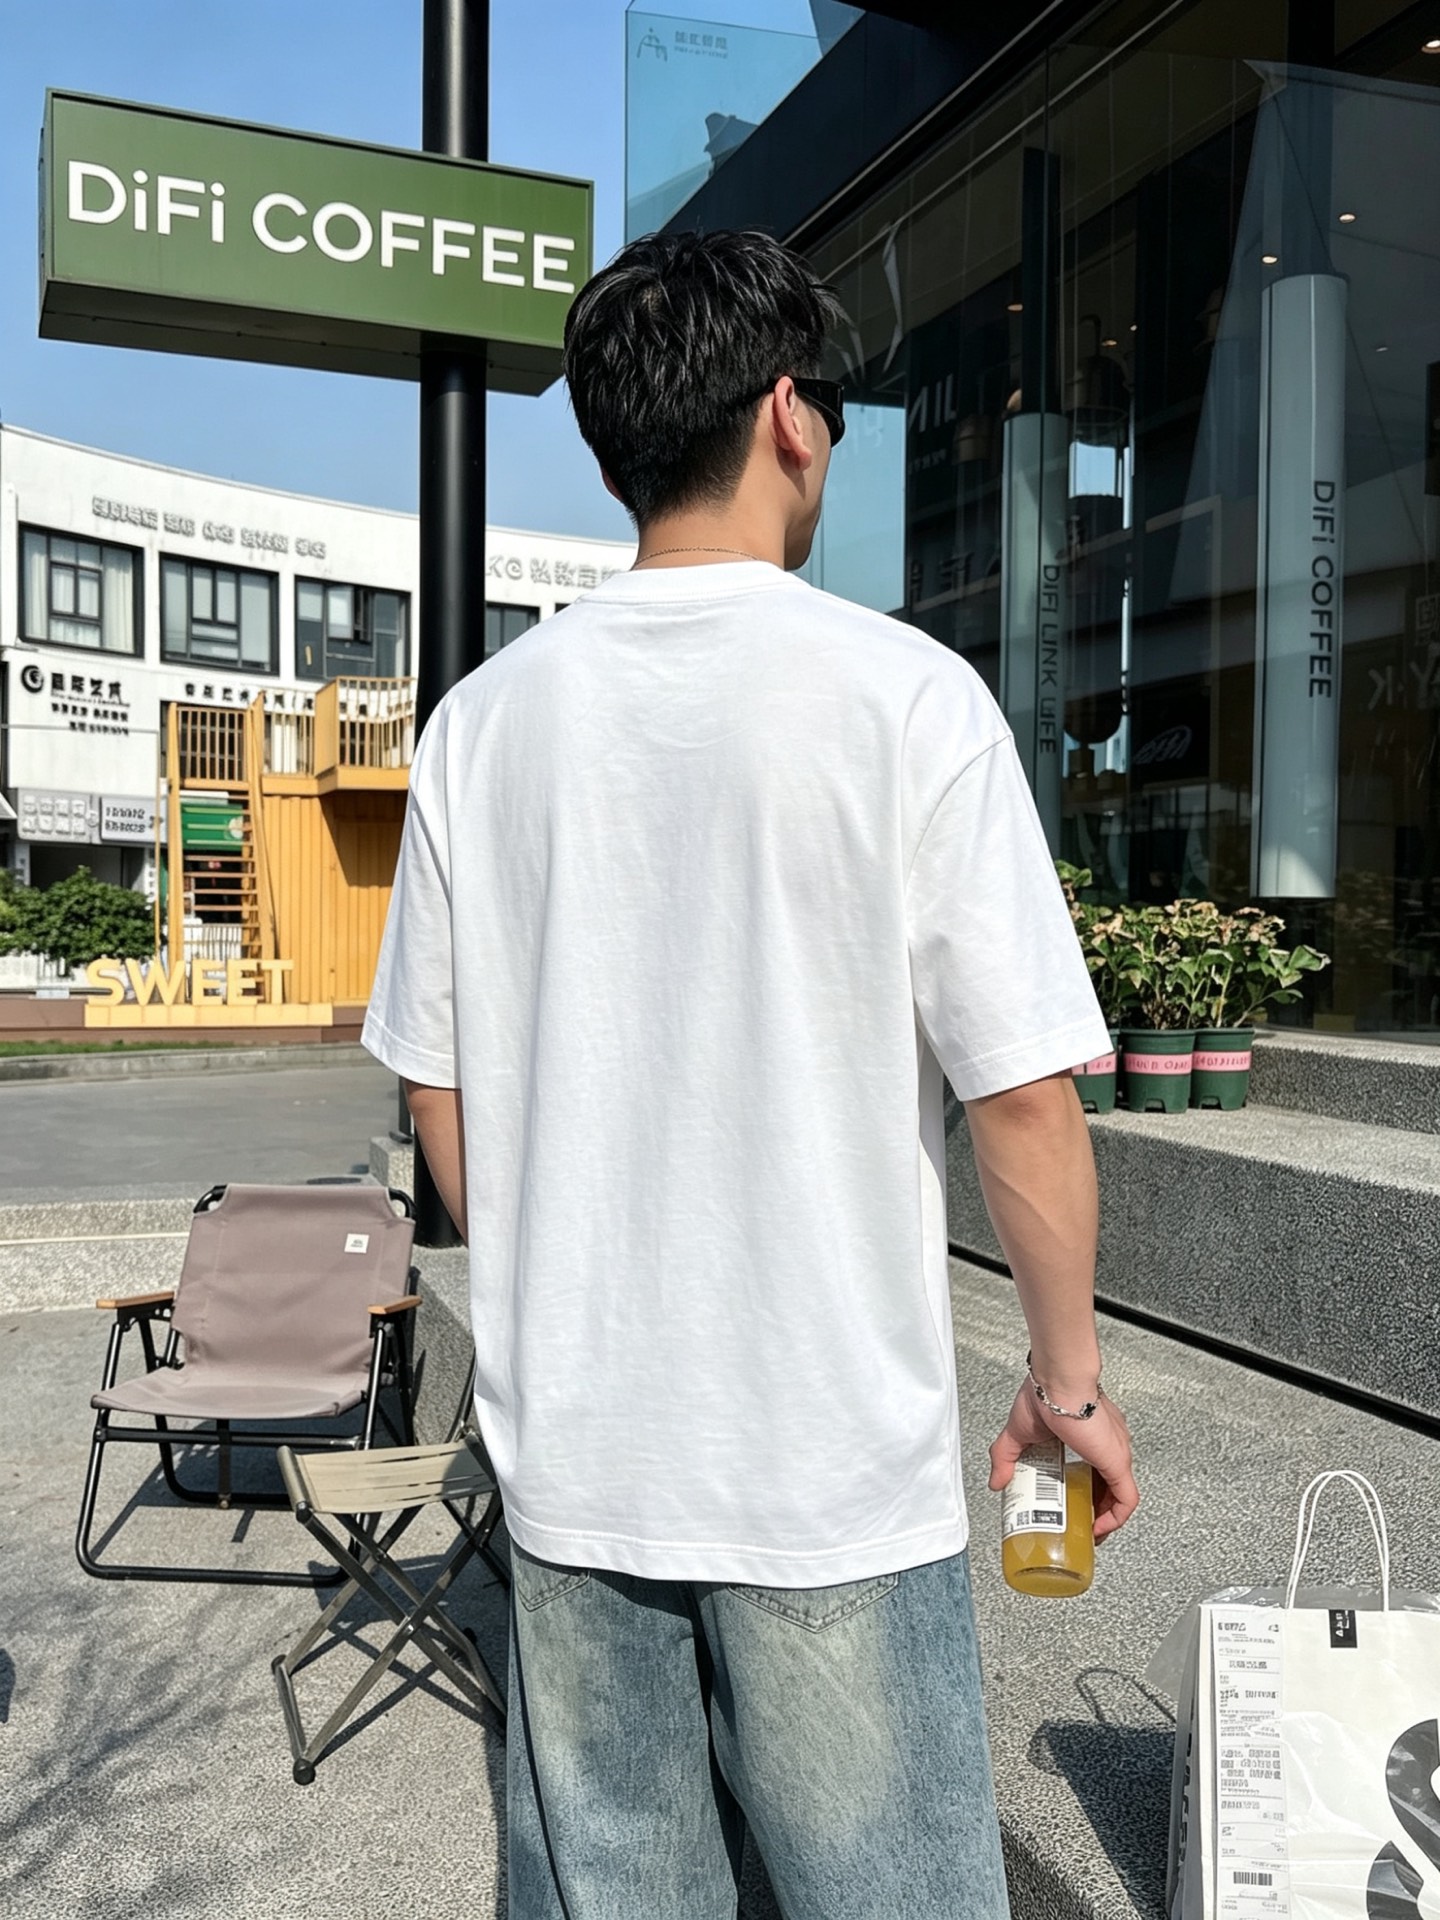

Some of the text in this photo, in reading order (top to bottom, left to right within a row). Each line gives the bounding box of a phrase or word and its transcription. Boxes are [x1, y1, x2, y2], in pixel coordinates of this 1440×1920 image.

[67, 159, 576, 295] DiFi COFFEE
[1039, 623, 1058, 687] LINK
[1309, 555, 1335, 698] COFFEE
[85, 957, 295, 1007] SWEET
